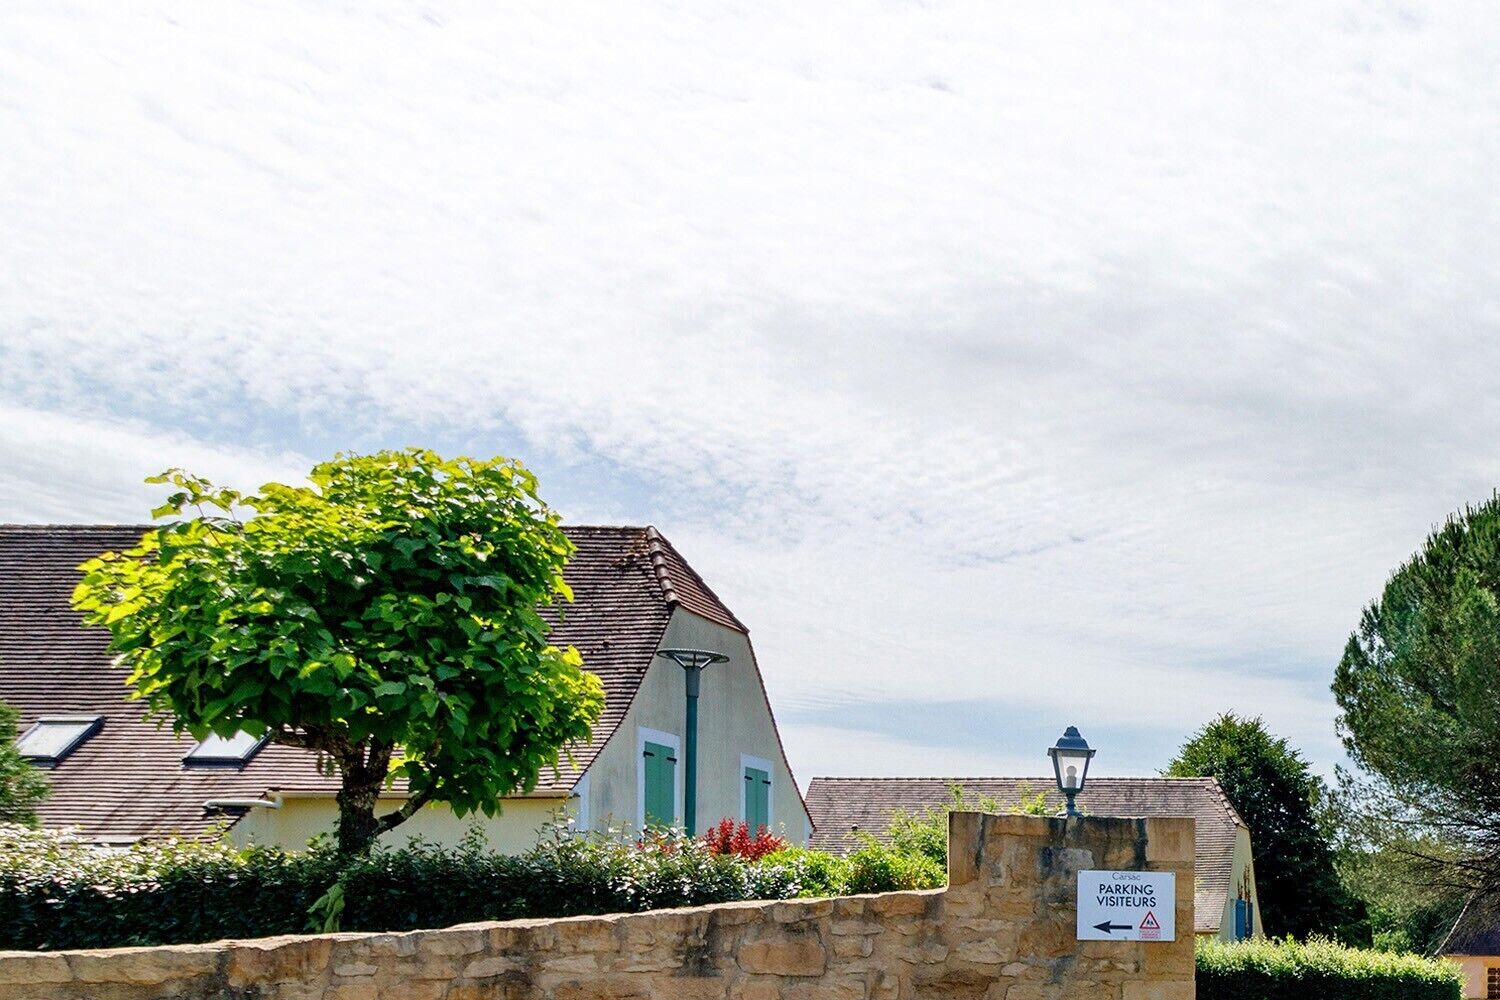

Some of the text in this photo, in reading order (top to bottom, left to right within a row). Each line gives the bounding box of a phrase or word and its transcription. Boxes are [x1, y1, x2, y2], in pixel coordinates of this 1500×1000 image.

[1112, 872, 1141, 880] Carsac
[1099, 884, 1154, 895] PARKING
[1096, 896, 1157, 907] VISITEURS
